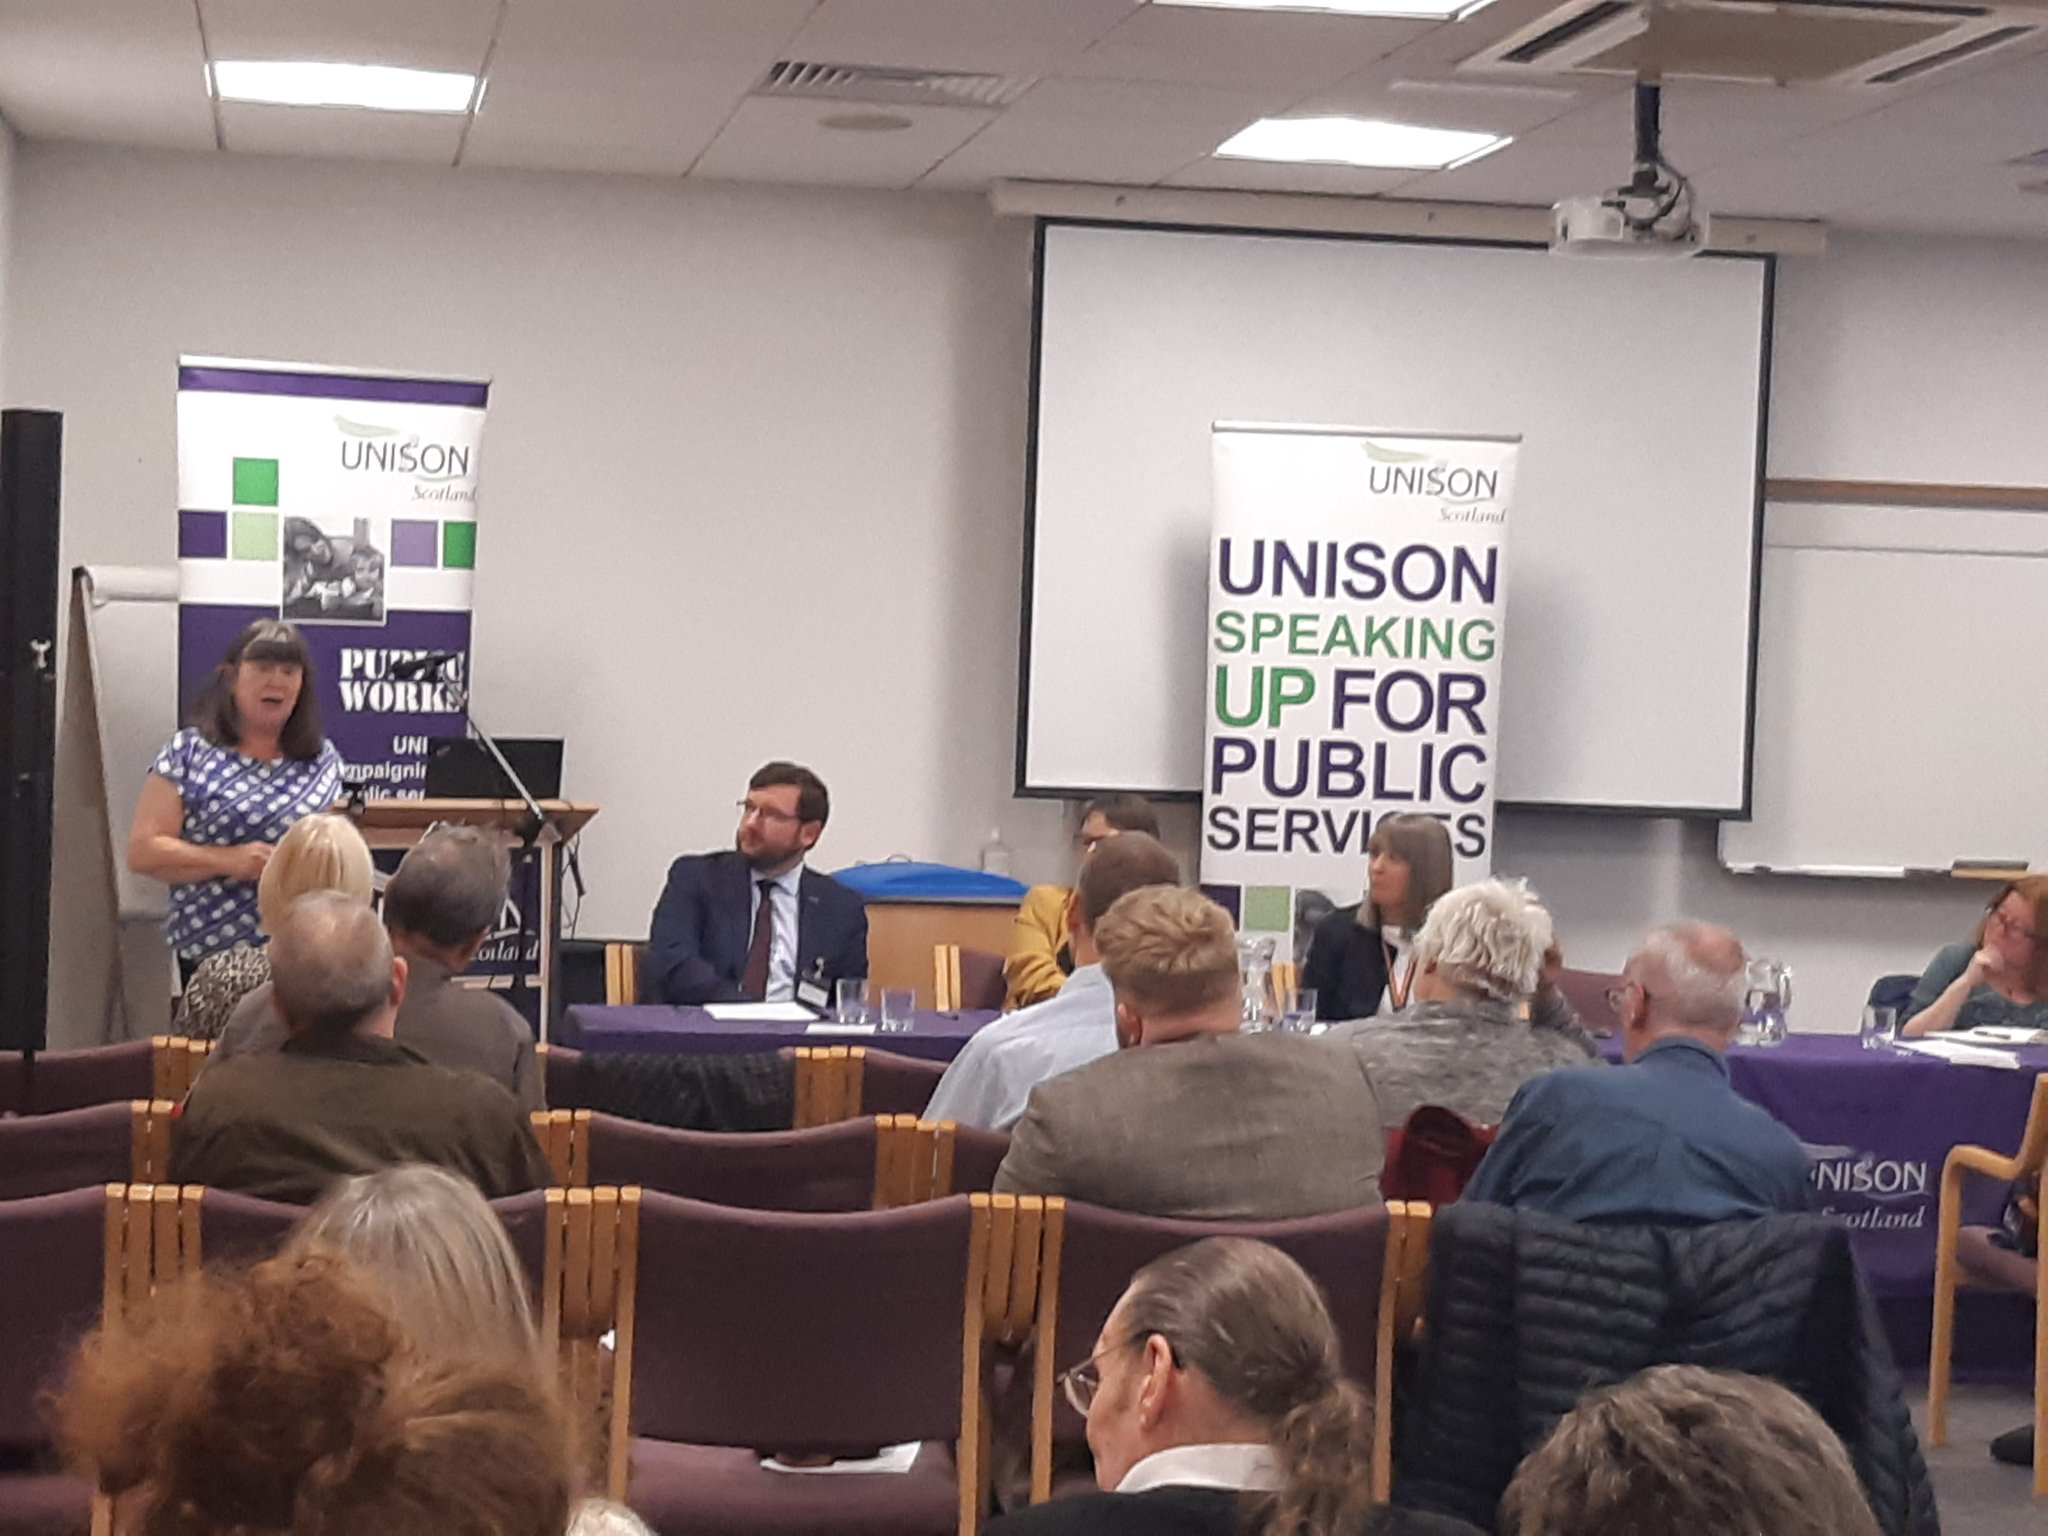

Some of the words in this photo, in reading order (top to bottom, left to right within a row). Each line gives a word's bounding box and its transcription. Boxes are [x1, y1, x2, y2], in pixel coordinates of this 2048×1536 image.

[341, 440, 469, 476] UNISON
[412, 484, 477, 502] Scotland
[1369, 466, 1498, 498] UNISON
[1440, 506, 1507, 521] Scotland
[1218, 537, 1498, 604] UNISON
[1214, 610, 1496, 662] SPEAKING
[1214, 665, 1316, 729] UP
[1331, 668, 1487, 735] FOR
[1210, 736, 1487, 803] PUBLIC
[1207, 806, 1487, 858] SERVIS
[1809, 1160, 1927, 1192] NISON
